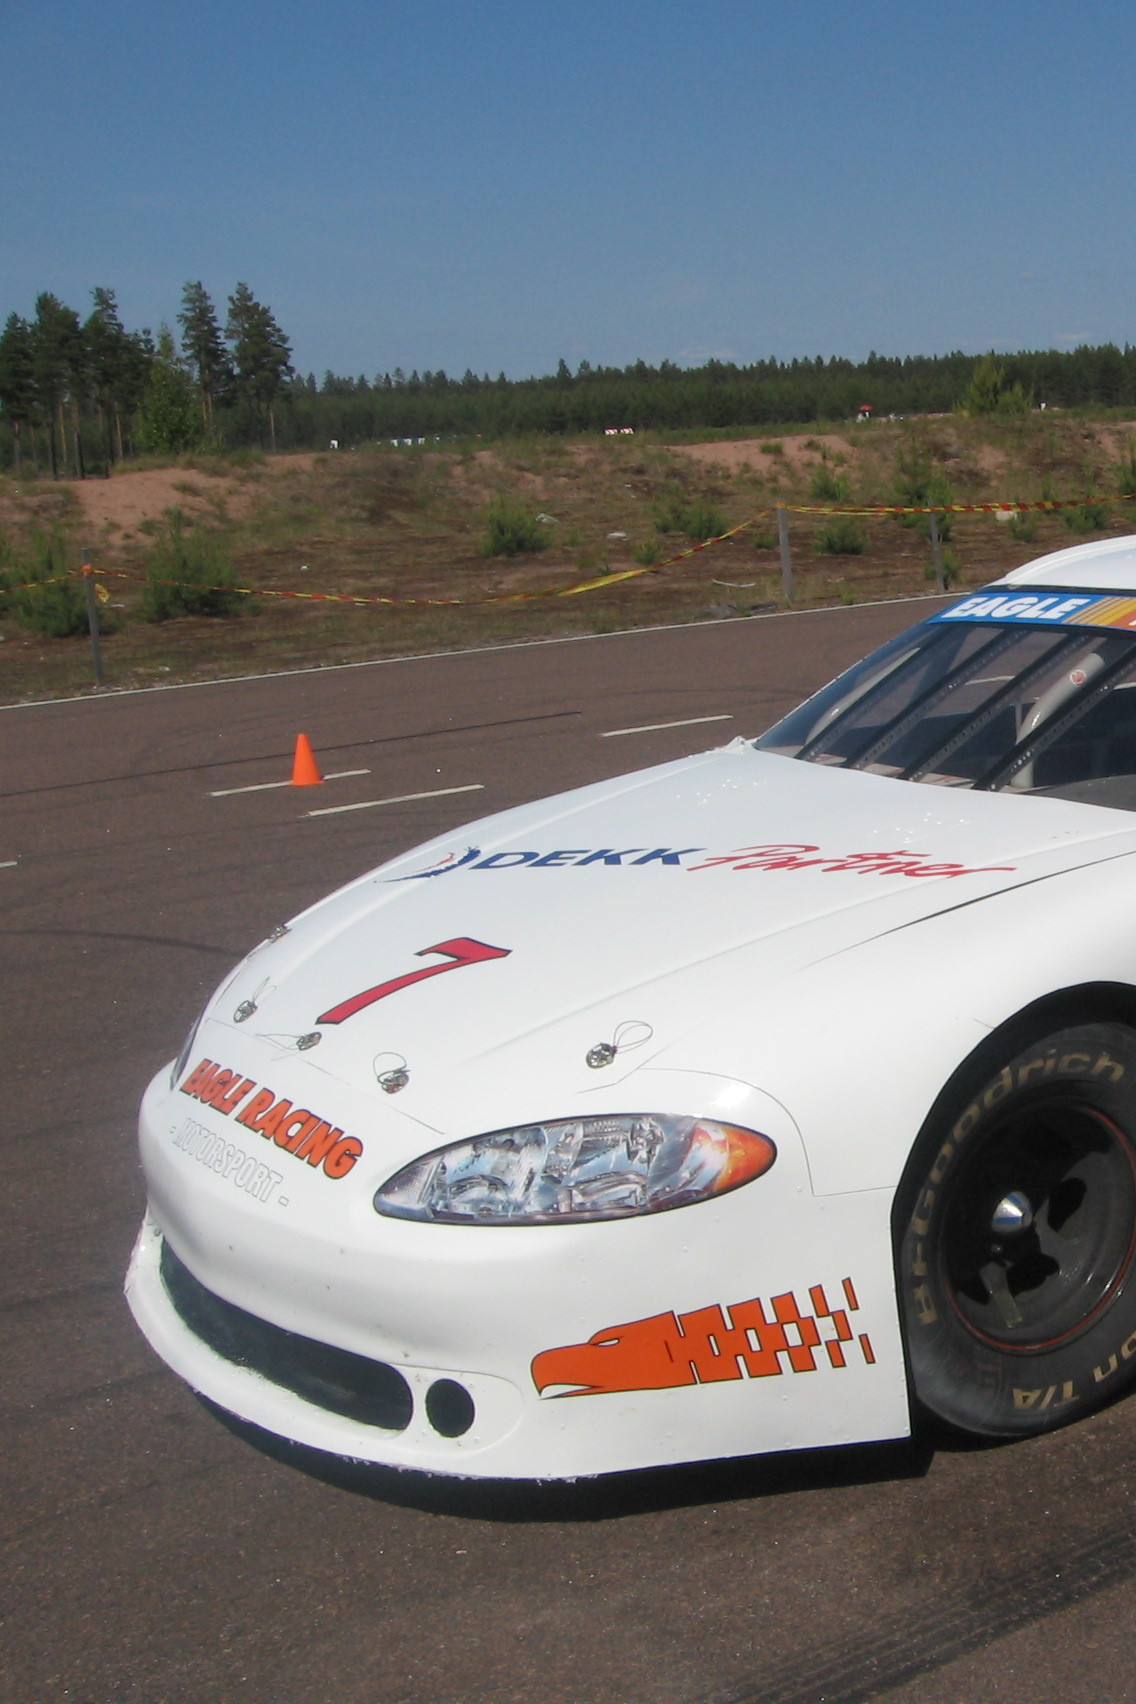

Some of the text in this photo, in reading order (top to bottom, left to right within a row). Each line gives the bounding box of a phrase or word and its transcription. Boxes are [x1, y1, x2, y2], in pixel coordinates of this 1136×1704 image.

[941, 596, 1091, 620] EAGLE
[468, 844, 1017, 878] DEKK Partner
[315, 937, 512, 1024] 7
[180, 1058, 364, 1180] EAGLE RACING
[1012, 1380, 1081, 1411] T/A
